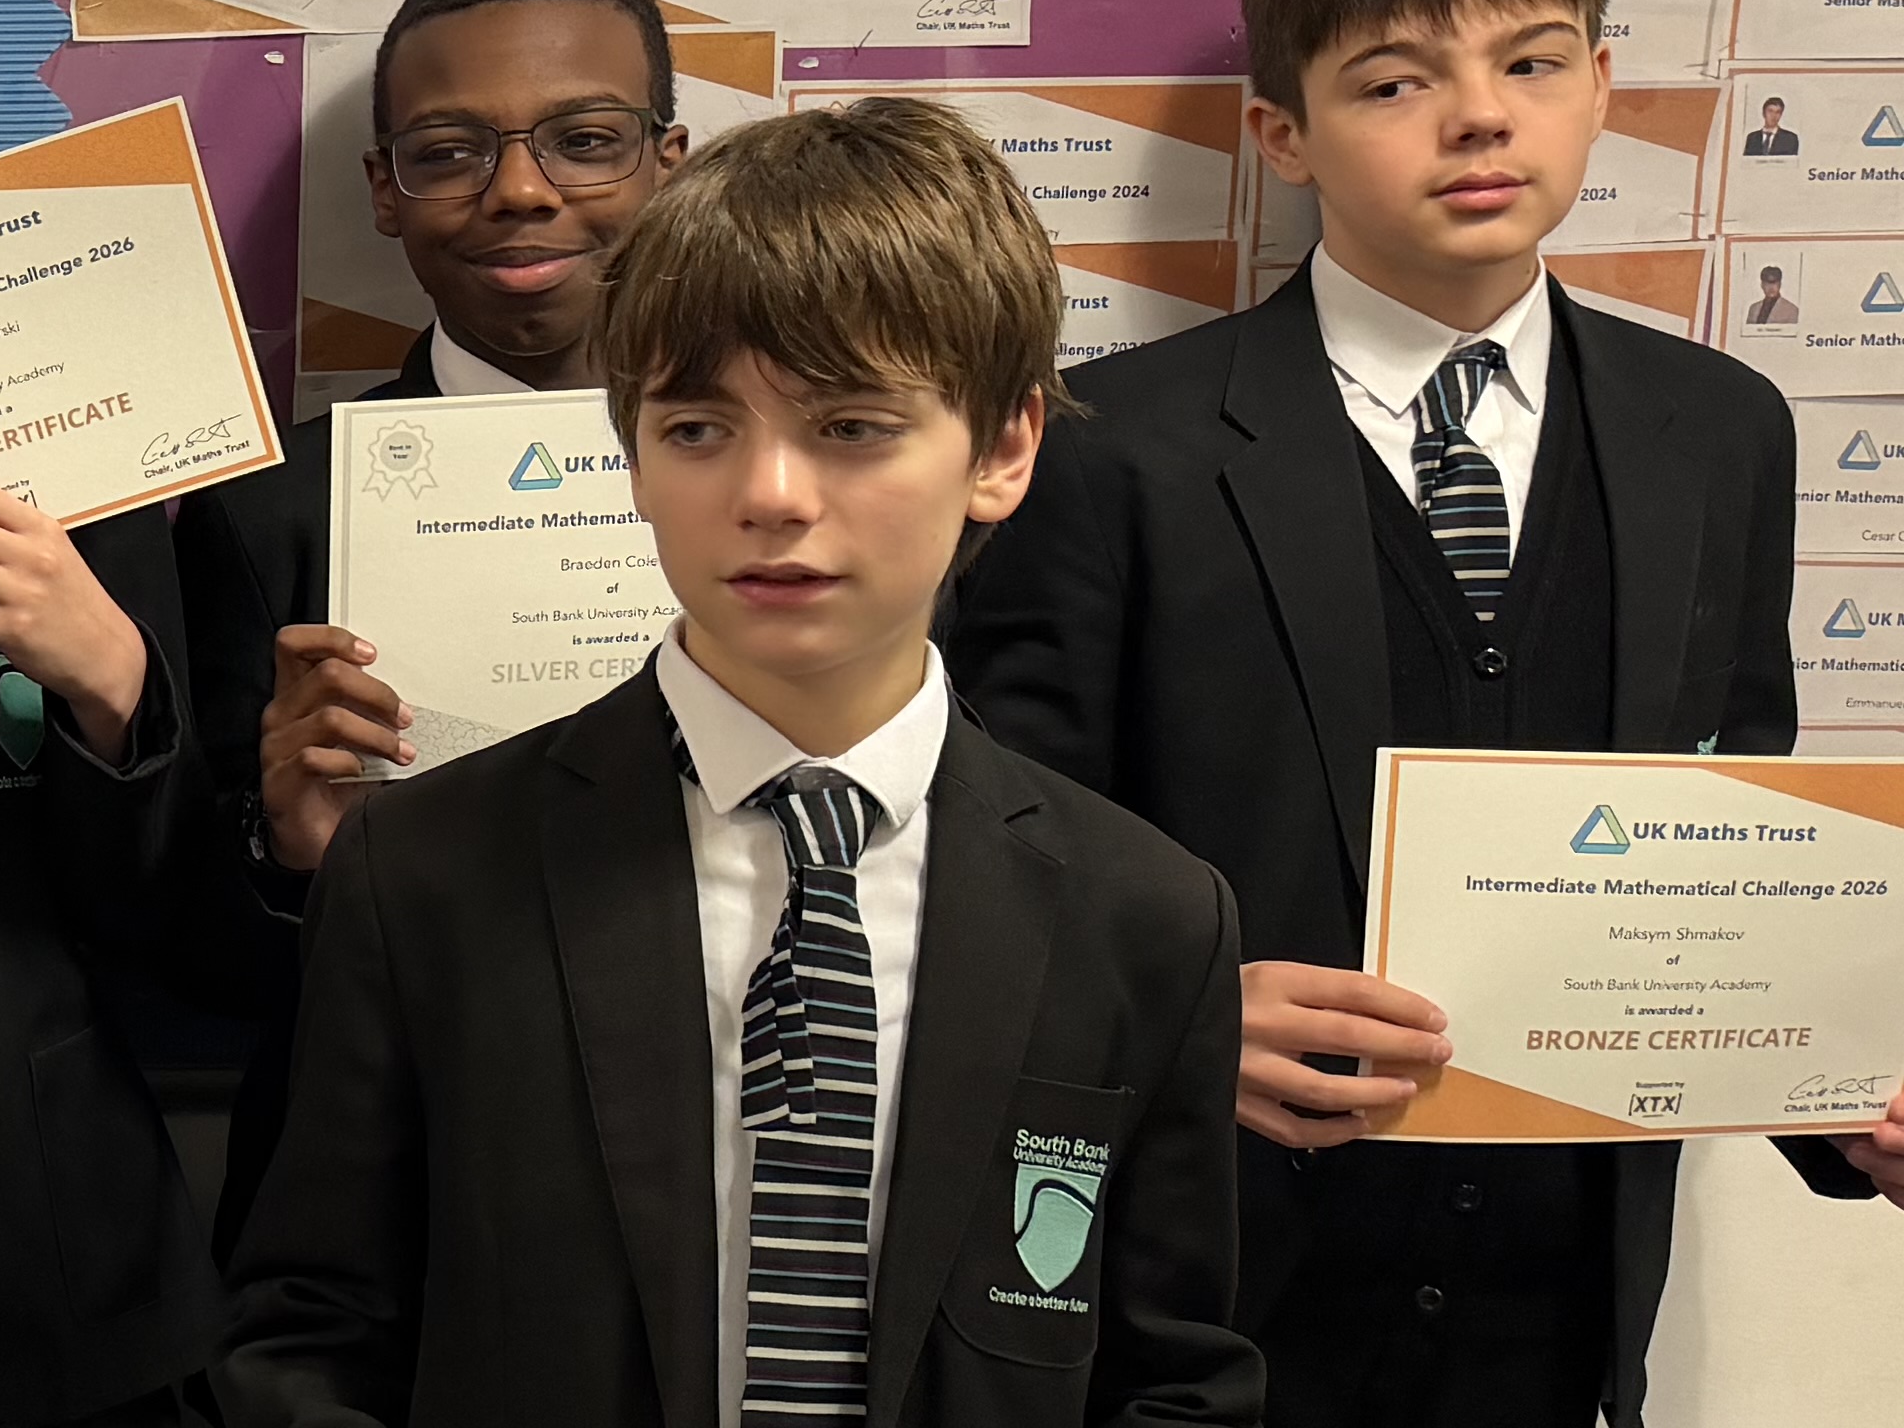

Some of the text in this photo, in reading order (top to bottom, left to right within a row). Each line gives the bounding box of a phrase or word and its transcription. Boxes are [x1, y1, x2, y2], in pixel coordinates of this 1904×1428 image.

[565, 456, 594, 472] UK
[417, 516, 534, 534] Intermediate
[491, 660, 579, 683] SILVER
[1466, 875, 1887, 900] Intermediate Mathematical Challenge 2026
[1609, 927, 1744, 943] Maksym Shmakov
[1527, 1027, 1812, 1050] BRONZE CERTIFICATE
[1015, 1129, 1110, 1161] South Bank
[989, 1286, 1027, 1307] Create
